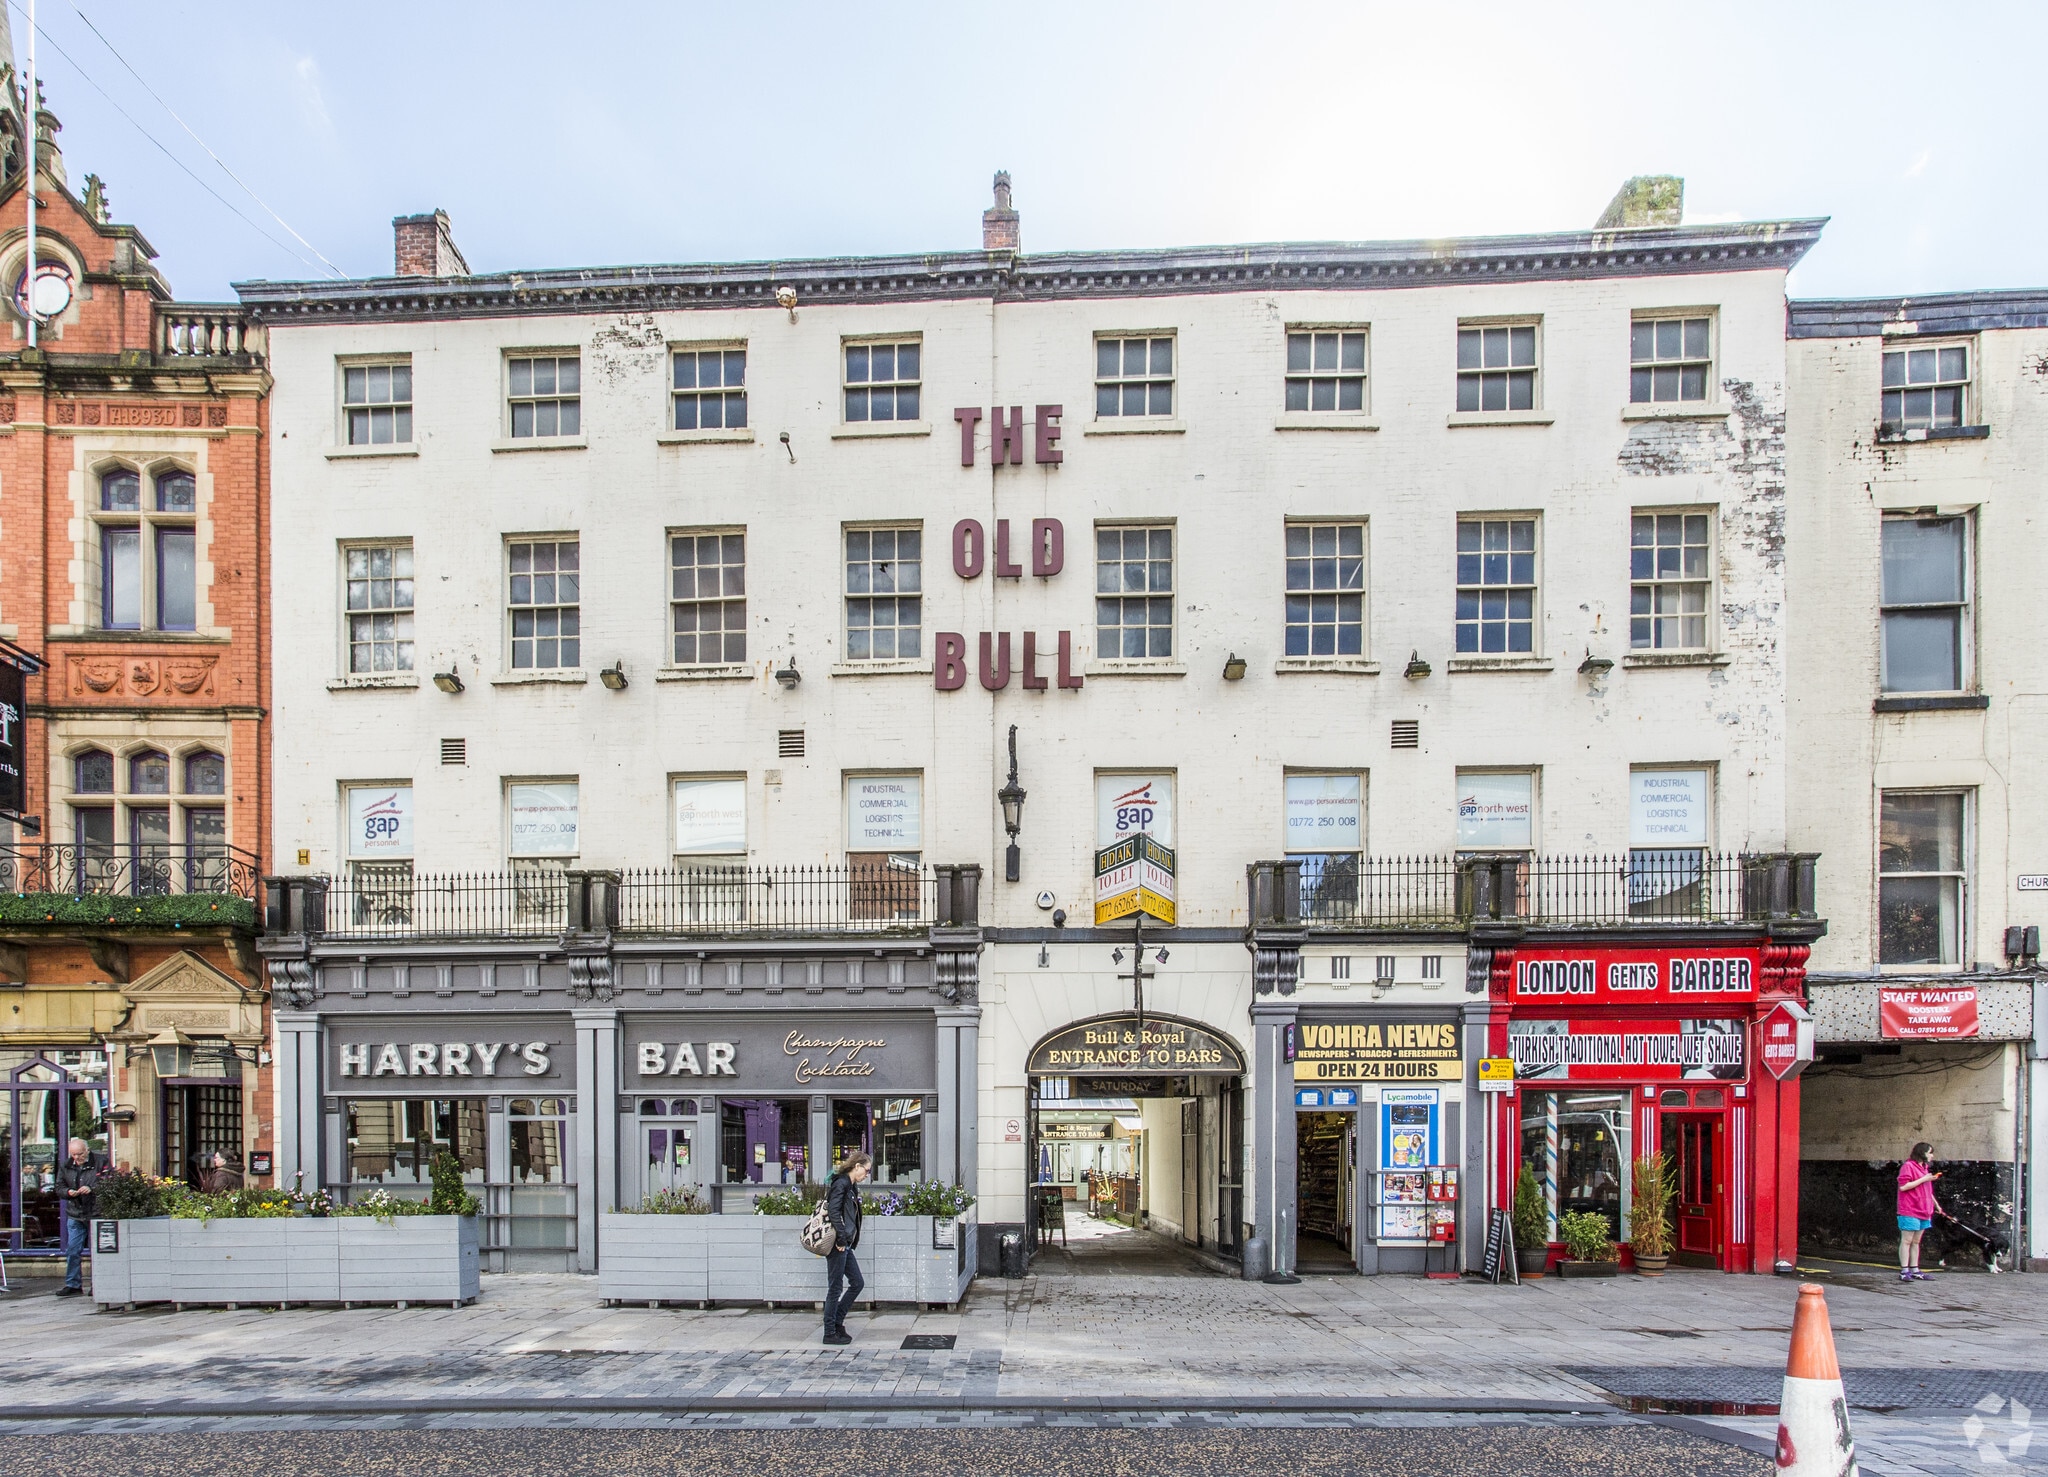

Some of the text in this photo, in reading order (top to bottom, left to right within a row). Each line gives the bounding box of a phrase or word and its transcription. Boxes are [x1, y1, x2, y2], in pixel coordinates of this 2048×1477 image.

[954, 404, 1063, 467] THE
[952, 518, 1064, 579] OLD
[935, 631, 1084, 691] BULL
[0, 763, 18, 776] rths
[862, 785, 905, 793] INDUSTRIAL
[1643, 779, 1690, 787] INDUSTRIAL
[860, 799, 908, 808] COMMERCIAL
[1641, 794, 1693, 803] COMMERCIAL
[1506, 804, 1528, 813] west
[1646, 809, 1688, 818] LOGISTICS
[865, 814, 903, 823] LOGISTICS
[1116, 807, 1153, 830] gap
[1289, 816, 1356, 826] 01772 250 008
[365, 817, 399, 839] gap
[514, 823, 576, 833] 01772 250 008
[864, 829, 904, 837] TECHNICAL
[1645, 824, 1688, 833] TECHNICAL
[364, 839, 400, 848] personnel
[1101, 842, 1133, 870] HDAK
[1147, 842, 1172, 868] HDAK
[1098, 874, 1111, 890] TO
[1114, 865, 1134, 885] LET
[1146, 864, 1158, 881] TO
[1159, 871, 1173, 891] LET
[1517, 958, 1751, 994] LONDON GENTS BARBER
[1882, 990, 1975, 1002] STAFF WANTED
[1908, 1006, 1950, 1014] ROOSTERZ
[1908, 1016, 1928, 1024] TAKE
[1085, 1030, 1185, 1047] Bull & Royal
[1302, 1024, 1456, 1048] VOHRA NEWS
[783, 1030, 886, 1060] Champagne
[1512, 1034, 1741, 1064] TURKISH TRADITIONAL HOT TOWEL WET SHAVE
[340, 1041, 551, 1076] HARRY'S
[638, 1042, 737, 1076] BAR
[1049, 1050, 1222, 1064] ENTRANCE TO BARS
[1298, 1050, 1349, 1058] NEWSPAPERS
[1356, 1050, 1392, 1058] TOBACCO
[1398, 1050, 1458, 1058] REFRESHMENTS
[795, 1058, 875, 1084] Cocktails
[1317, 1063, 1438, 1077] OPEN 24 HOURS
[1092, 1080, 1150, 1092] SATURDAY
[1387, 1093, 1432, 1102] Lycamobile
